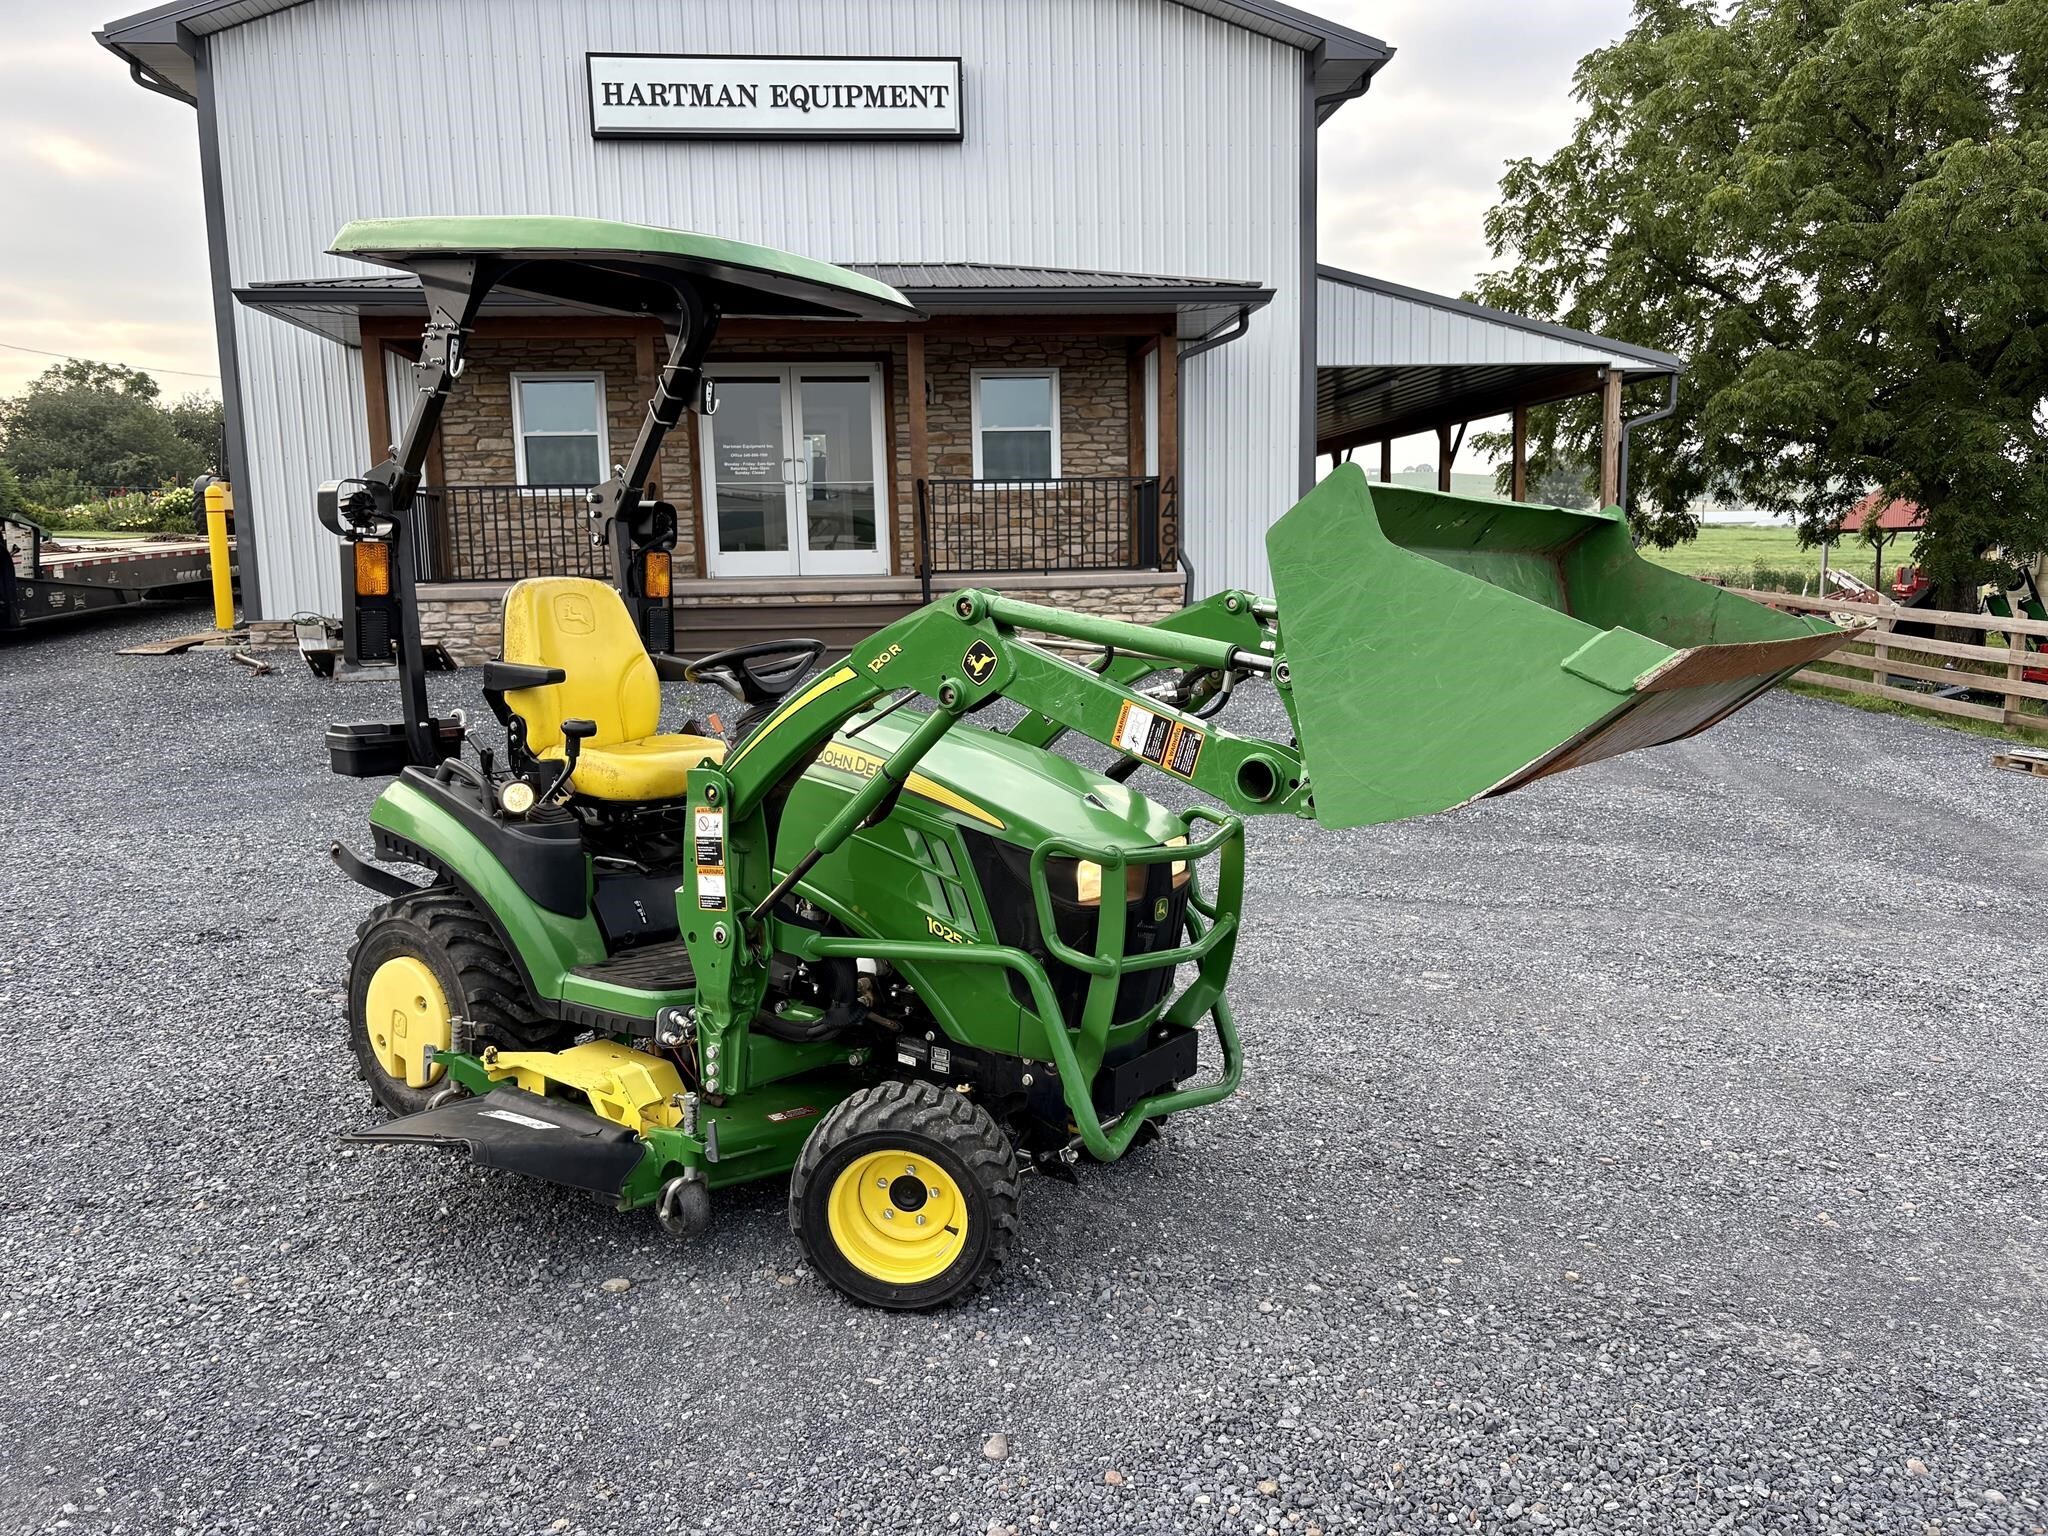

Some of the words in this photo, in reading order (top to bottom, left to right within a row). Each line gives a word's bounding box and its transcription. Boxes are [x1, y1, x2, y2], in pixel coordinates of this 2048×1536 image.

[601, 82, 758, 107] HARTMAN
[769, 84, 949, 112] EQUIPMENT
[1161, 475, 1177, 569] 4484
[1116, 705, 1129, 734] WARNING
[1169, 727, 1182, 757] WARNING
[817, 750, 853, 769] JOHN
[702, 867, 724, 875] WARNING
